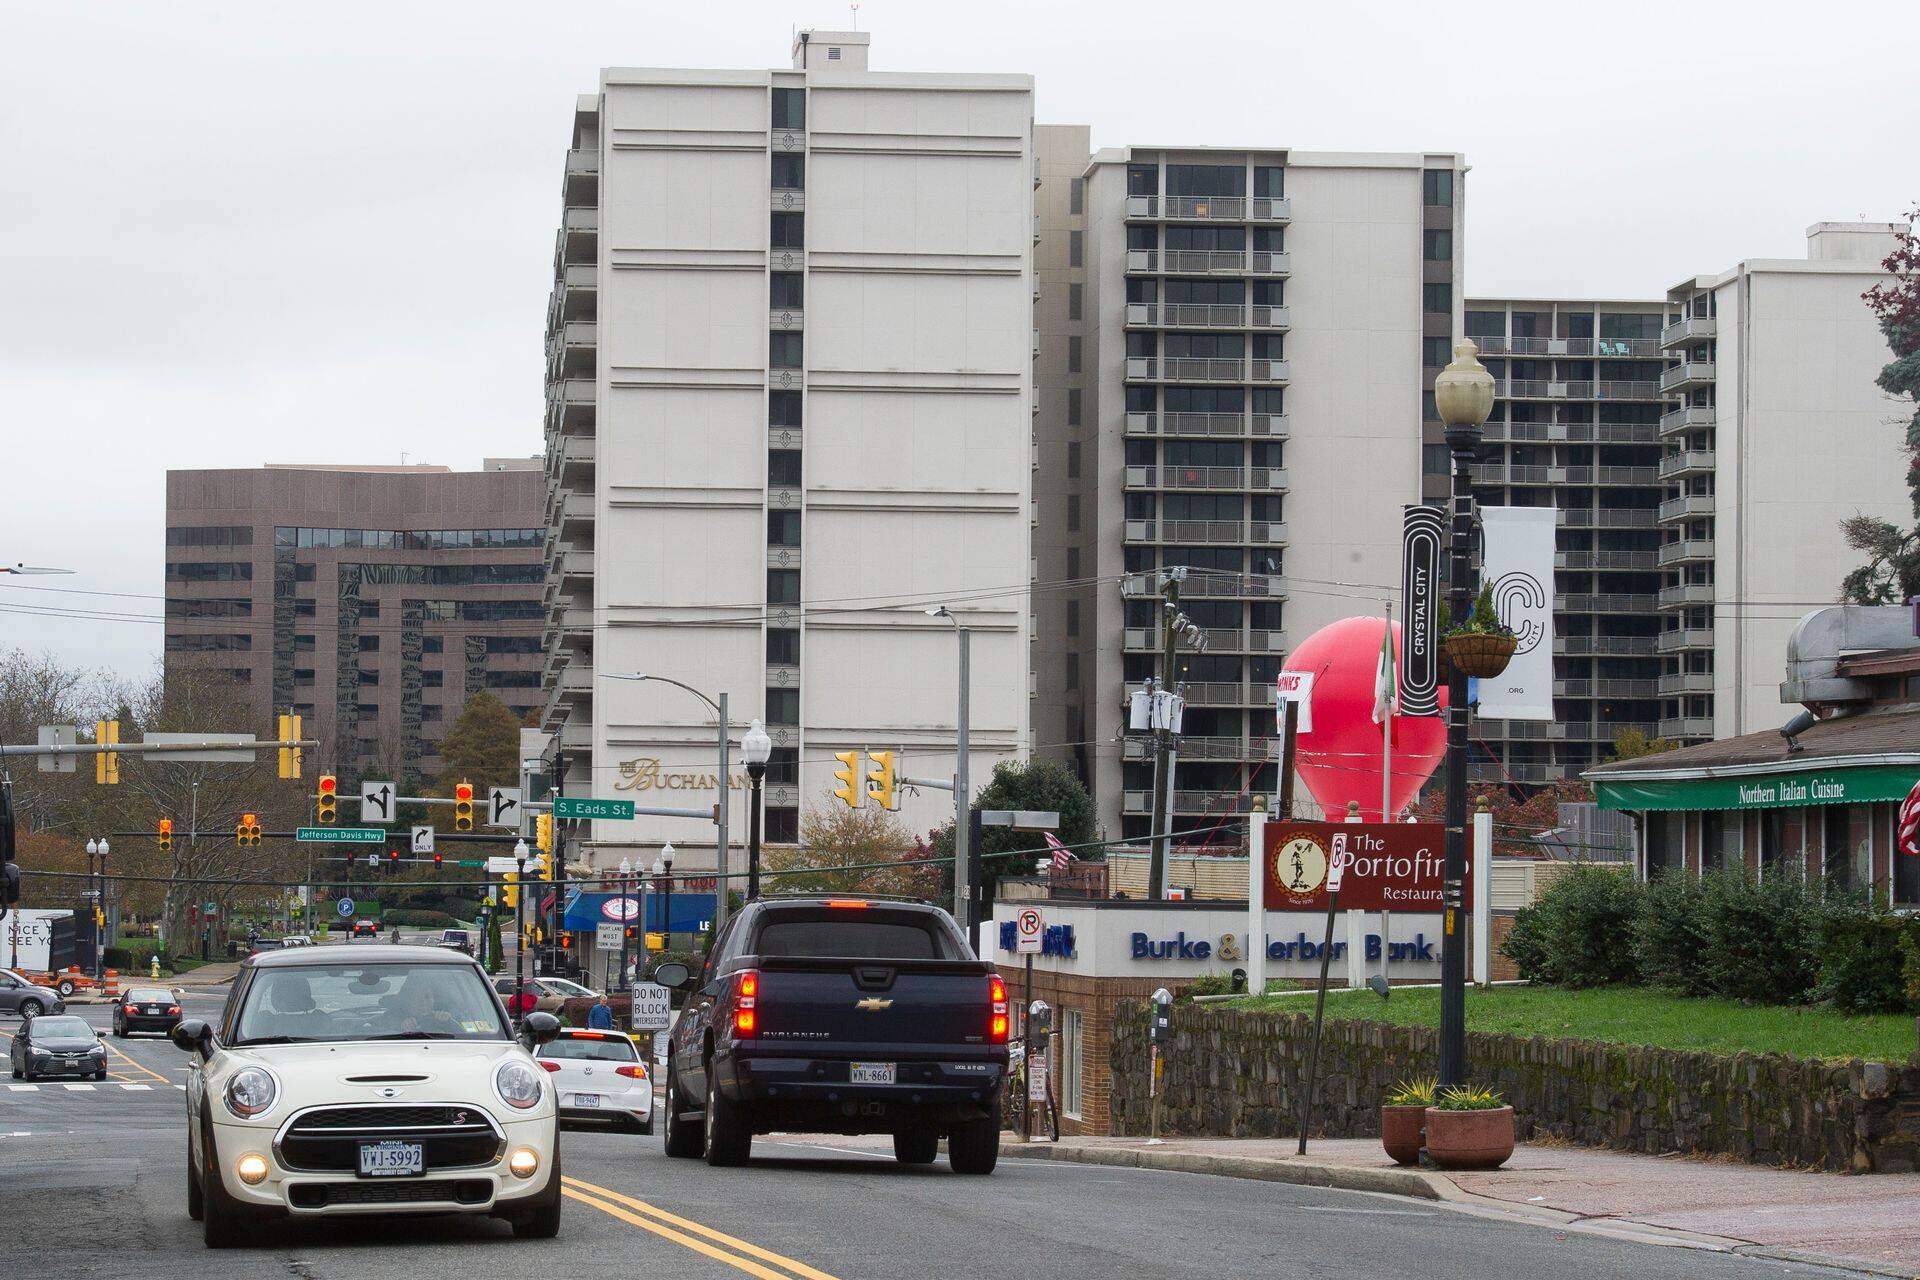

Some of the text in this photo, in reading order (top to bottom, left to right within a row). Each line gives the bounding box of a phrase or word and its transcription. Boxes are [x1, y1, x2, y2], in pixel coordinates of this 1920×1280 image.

[1414, 566, 1427, 655] CRYSTAL CITY
[1527, 624, 1540, 645] CITY
[1739, 778, 1845, 804] Northern Italian Cuisine
[559, 802, 630, 815] S. Eads St.
[300, 831, 382, 840] Jefferson Davis Hwy
[1354, 833, 1385, 850] The
[1384, 887, 1444, 900] Restaura
[8, 925, 39, 935] NICE
[8, 936, 33, 946] SEE
[1131, 931, 1211, 960] Burke
[1218, 933, 1241, 960] &
[1365, 933, 1433, 961] Bank
[634, 988, 668, 999] DO NOT
[634, 1003, 668, 1015] BLOCK
[634, 1016, 669, 1025] INTERSECTION
[762, 1031, 831, 1039] AVALANCHE
[852, 1069, 893, 1081] WNL-8661
[453, 1111, 467, 1125] S
[363, 1150, 421, 1167] VWJ-5992
